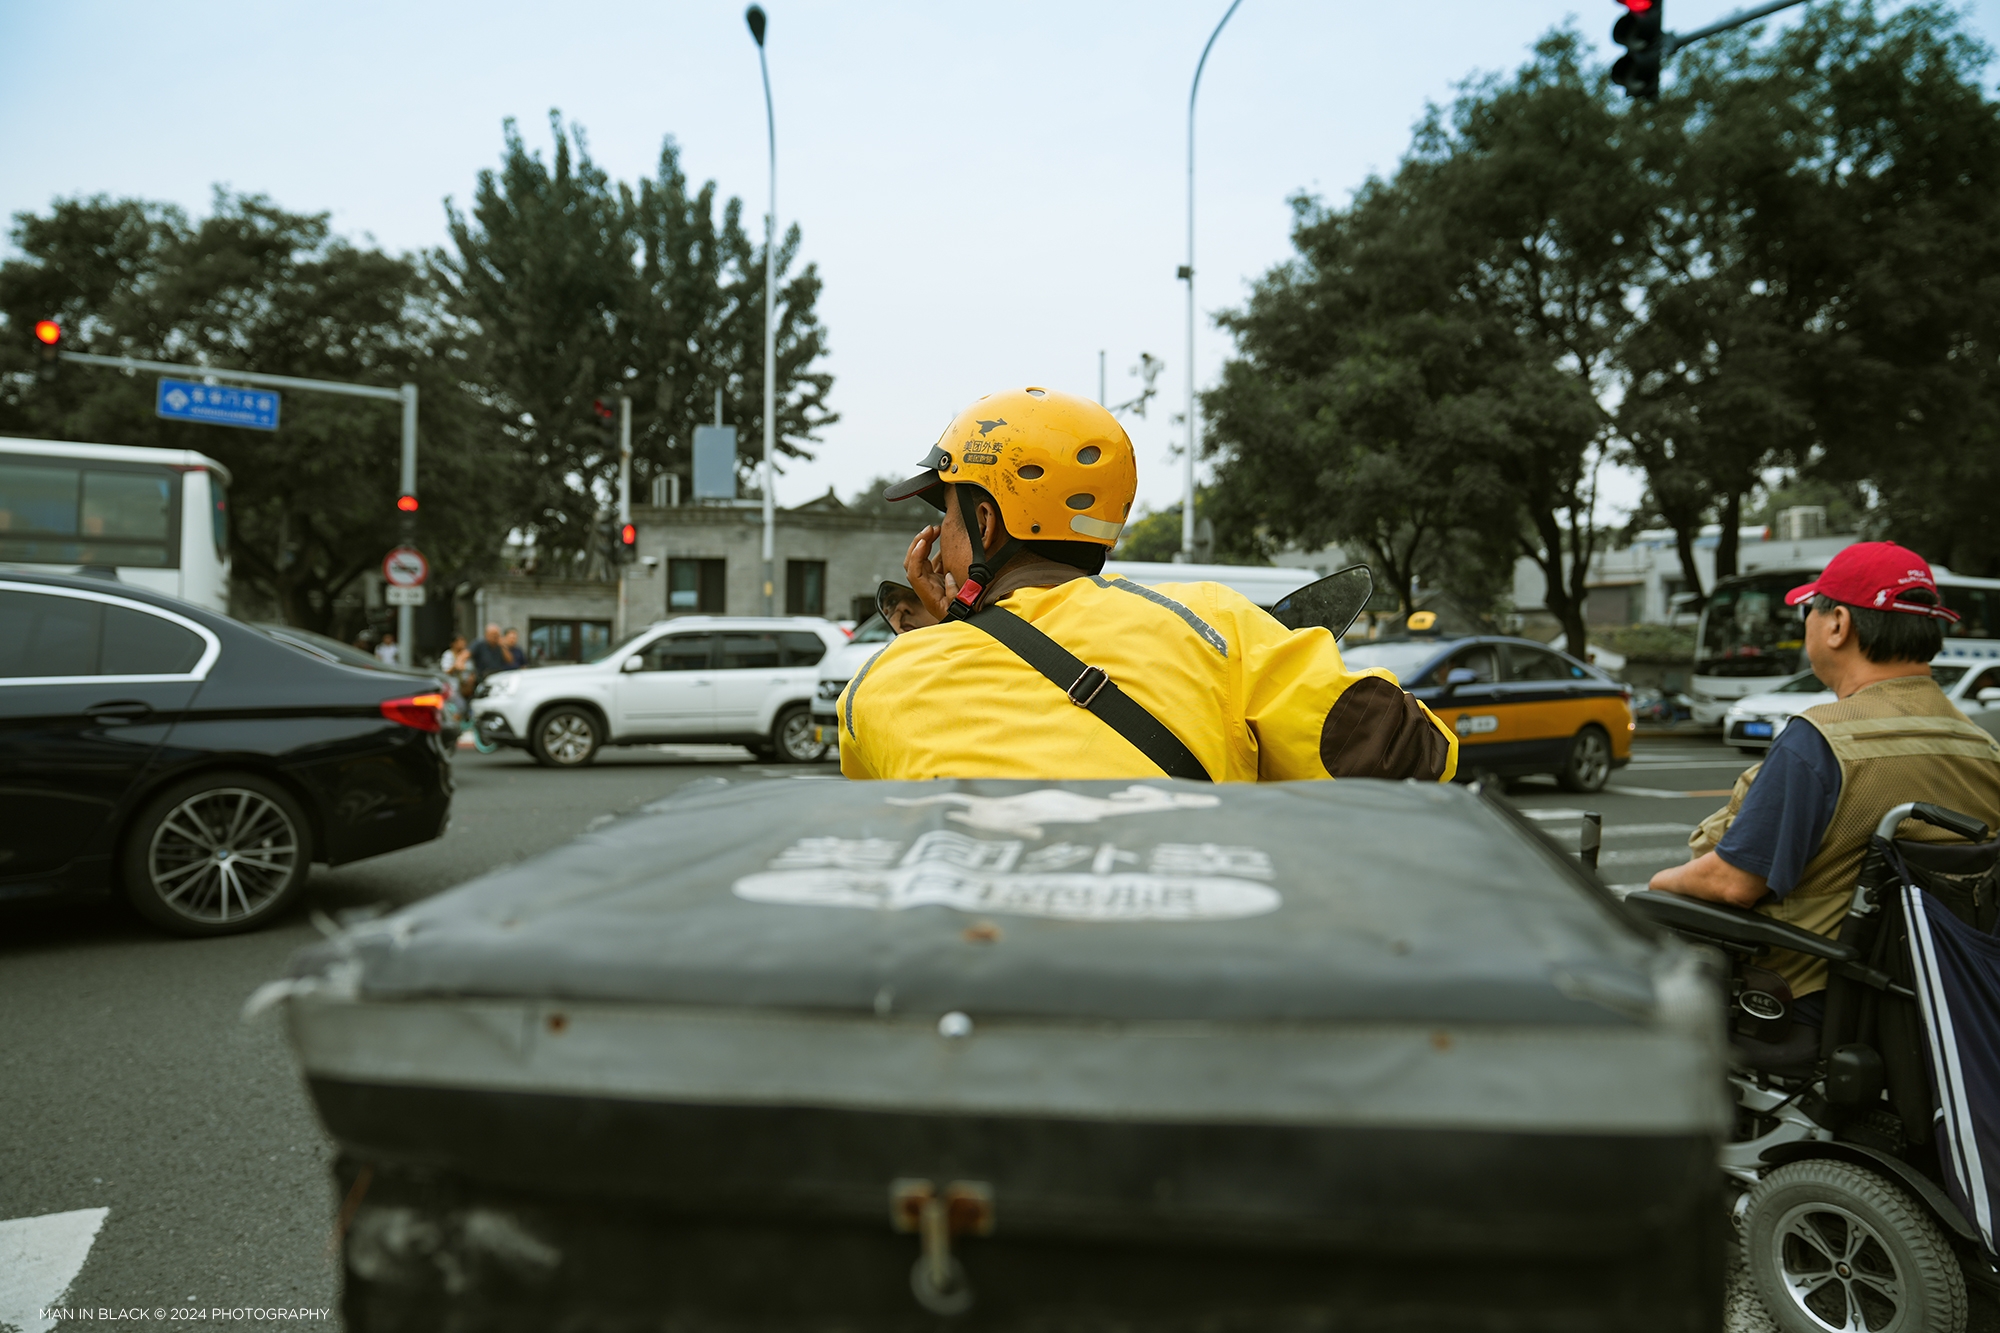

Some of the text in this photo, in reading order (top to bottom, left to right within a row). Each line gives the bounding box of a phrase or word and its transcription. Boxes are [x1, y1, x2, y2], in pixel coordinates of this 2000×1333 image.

[963, 440, 1003, 454] 美团外卖
[768, 830, 1276, 880] 美团外卖
